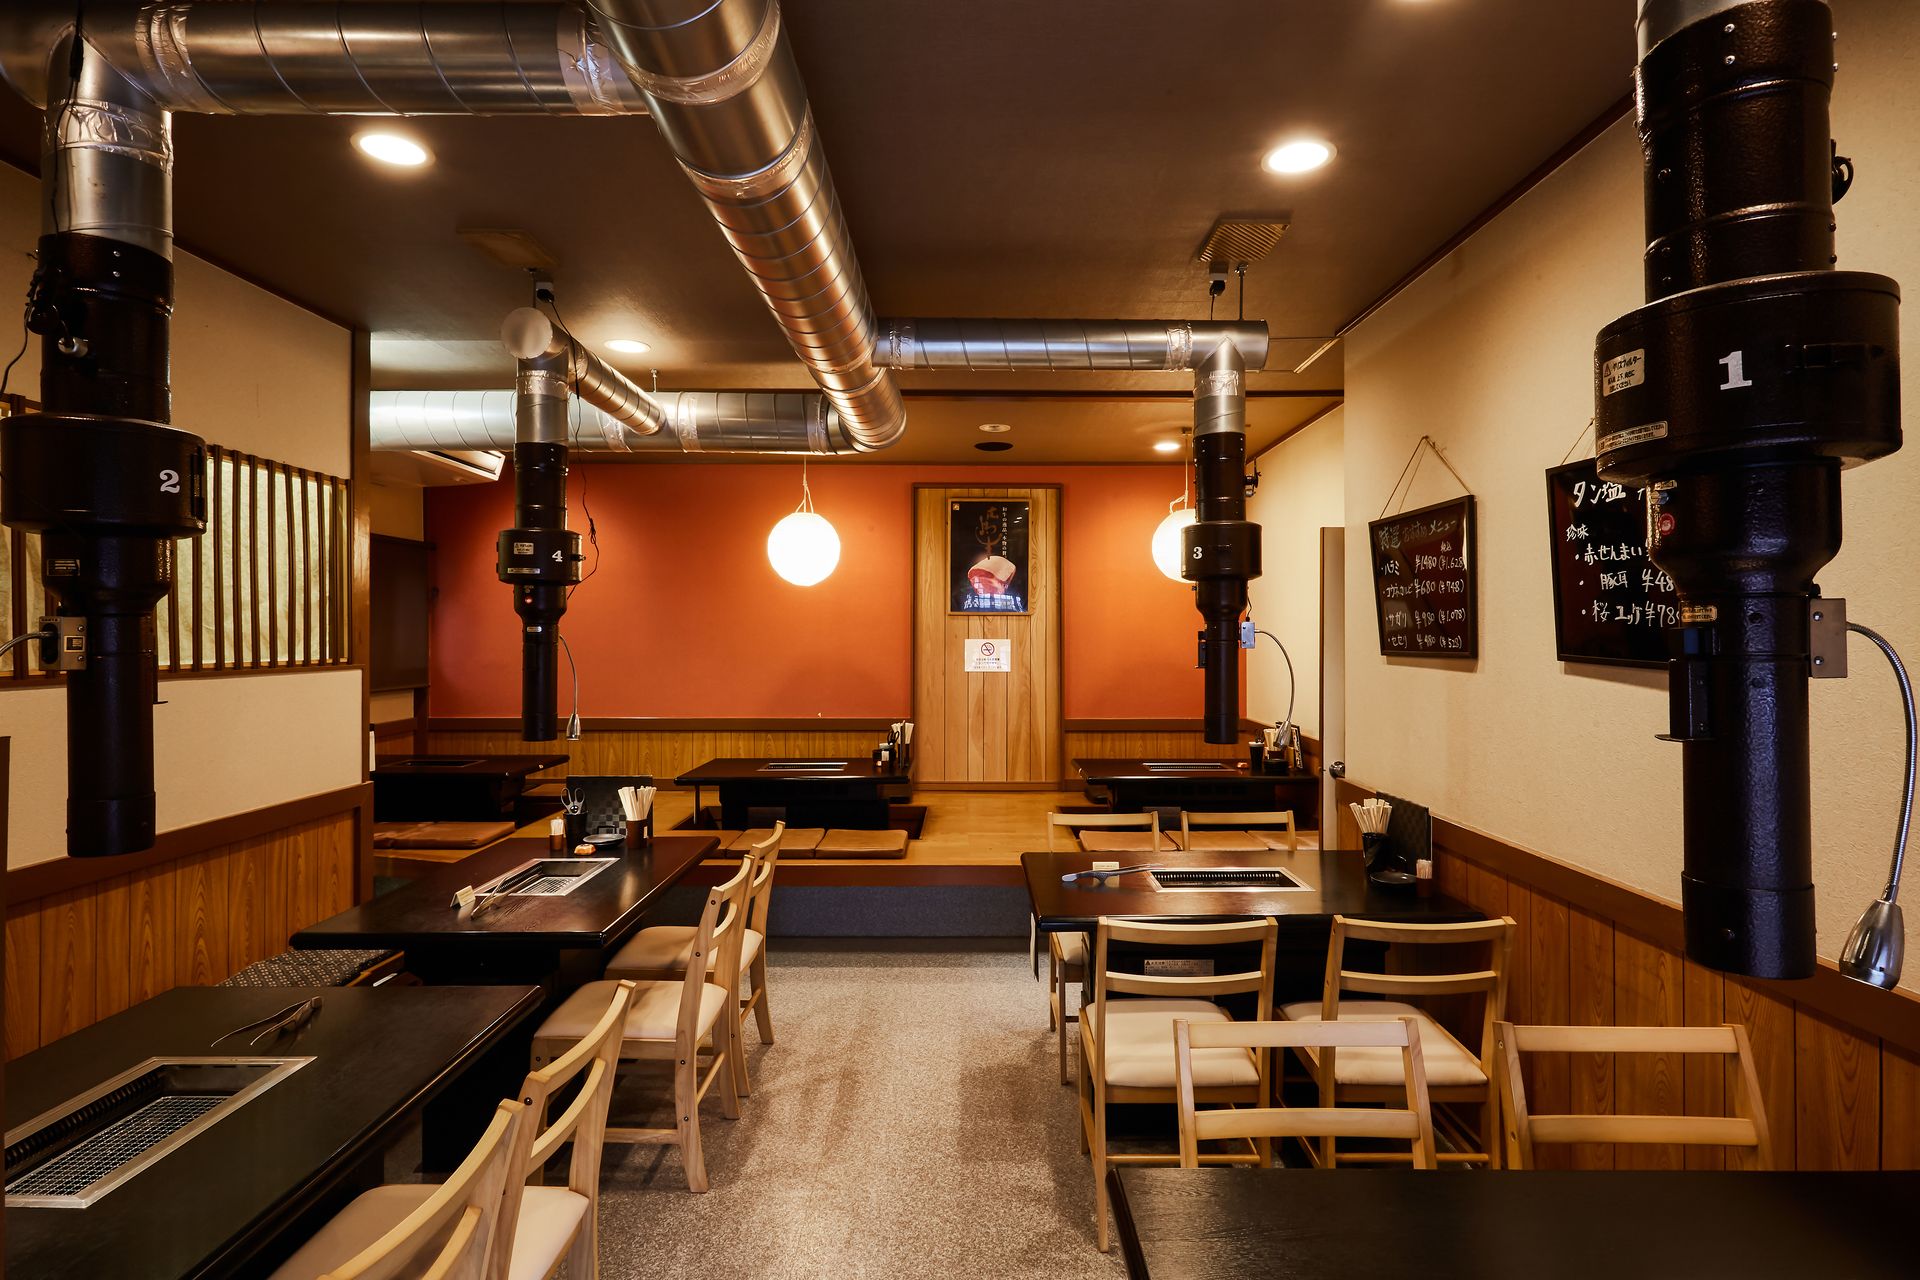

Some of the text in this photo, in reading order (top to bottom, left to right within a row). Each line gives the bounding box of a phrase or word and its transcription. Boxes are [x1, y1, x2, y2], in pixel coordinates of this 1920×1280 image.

[1719, 350, 1752, 390] 1
[159, 469, 181, 493] 2
[1573, 480, 1627, 508] タン塩
[1565, 523, 1590, 542] 珍味
[552, 550, 563, 562] 4
[1193, 547, 1203, 559] 3
